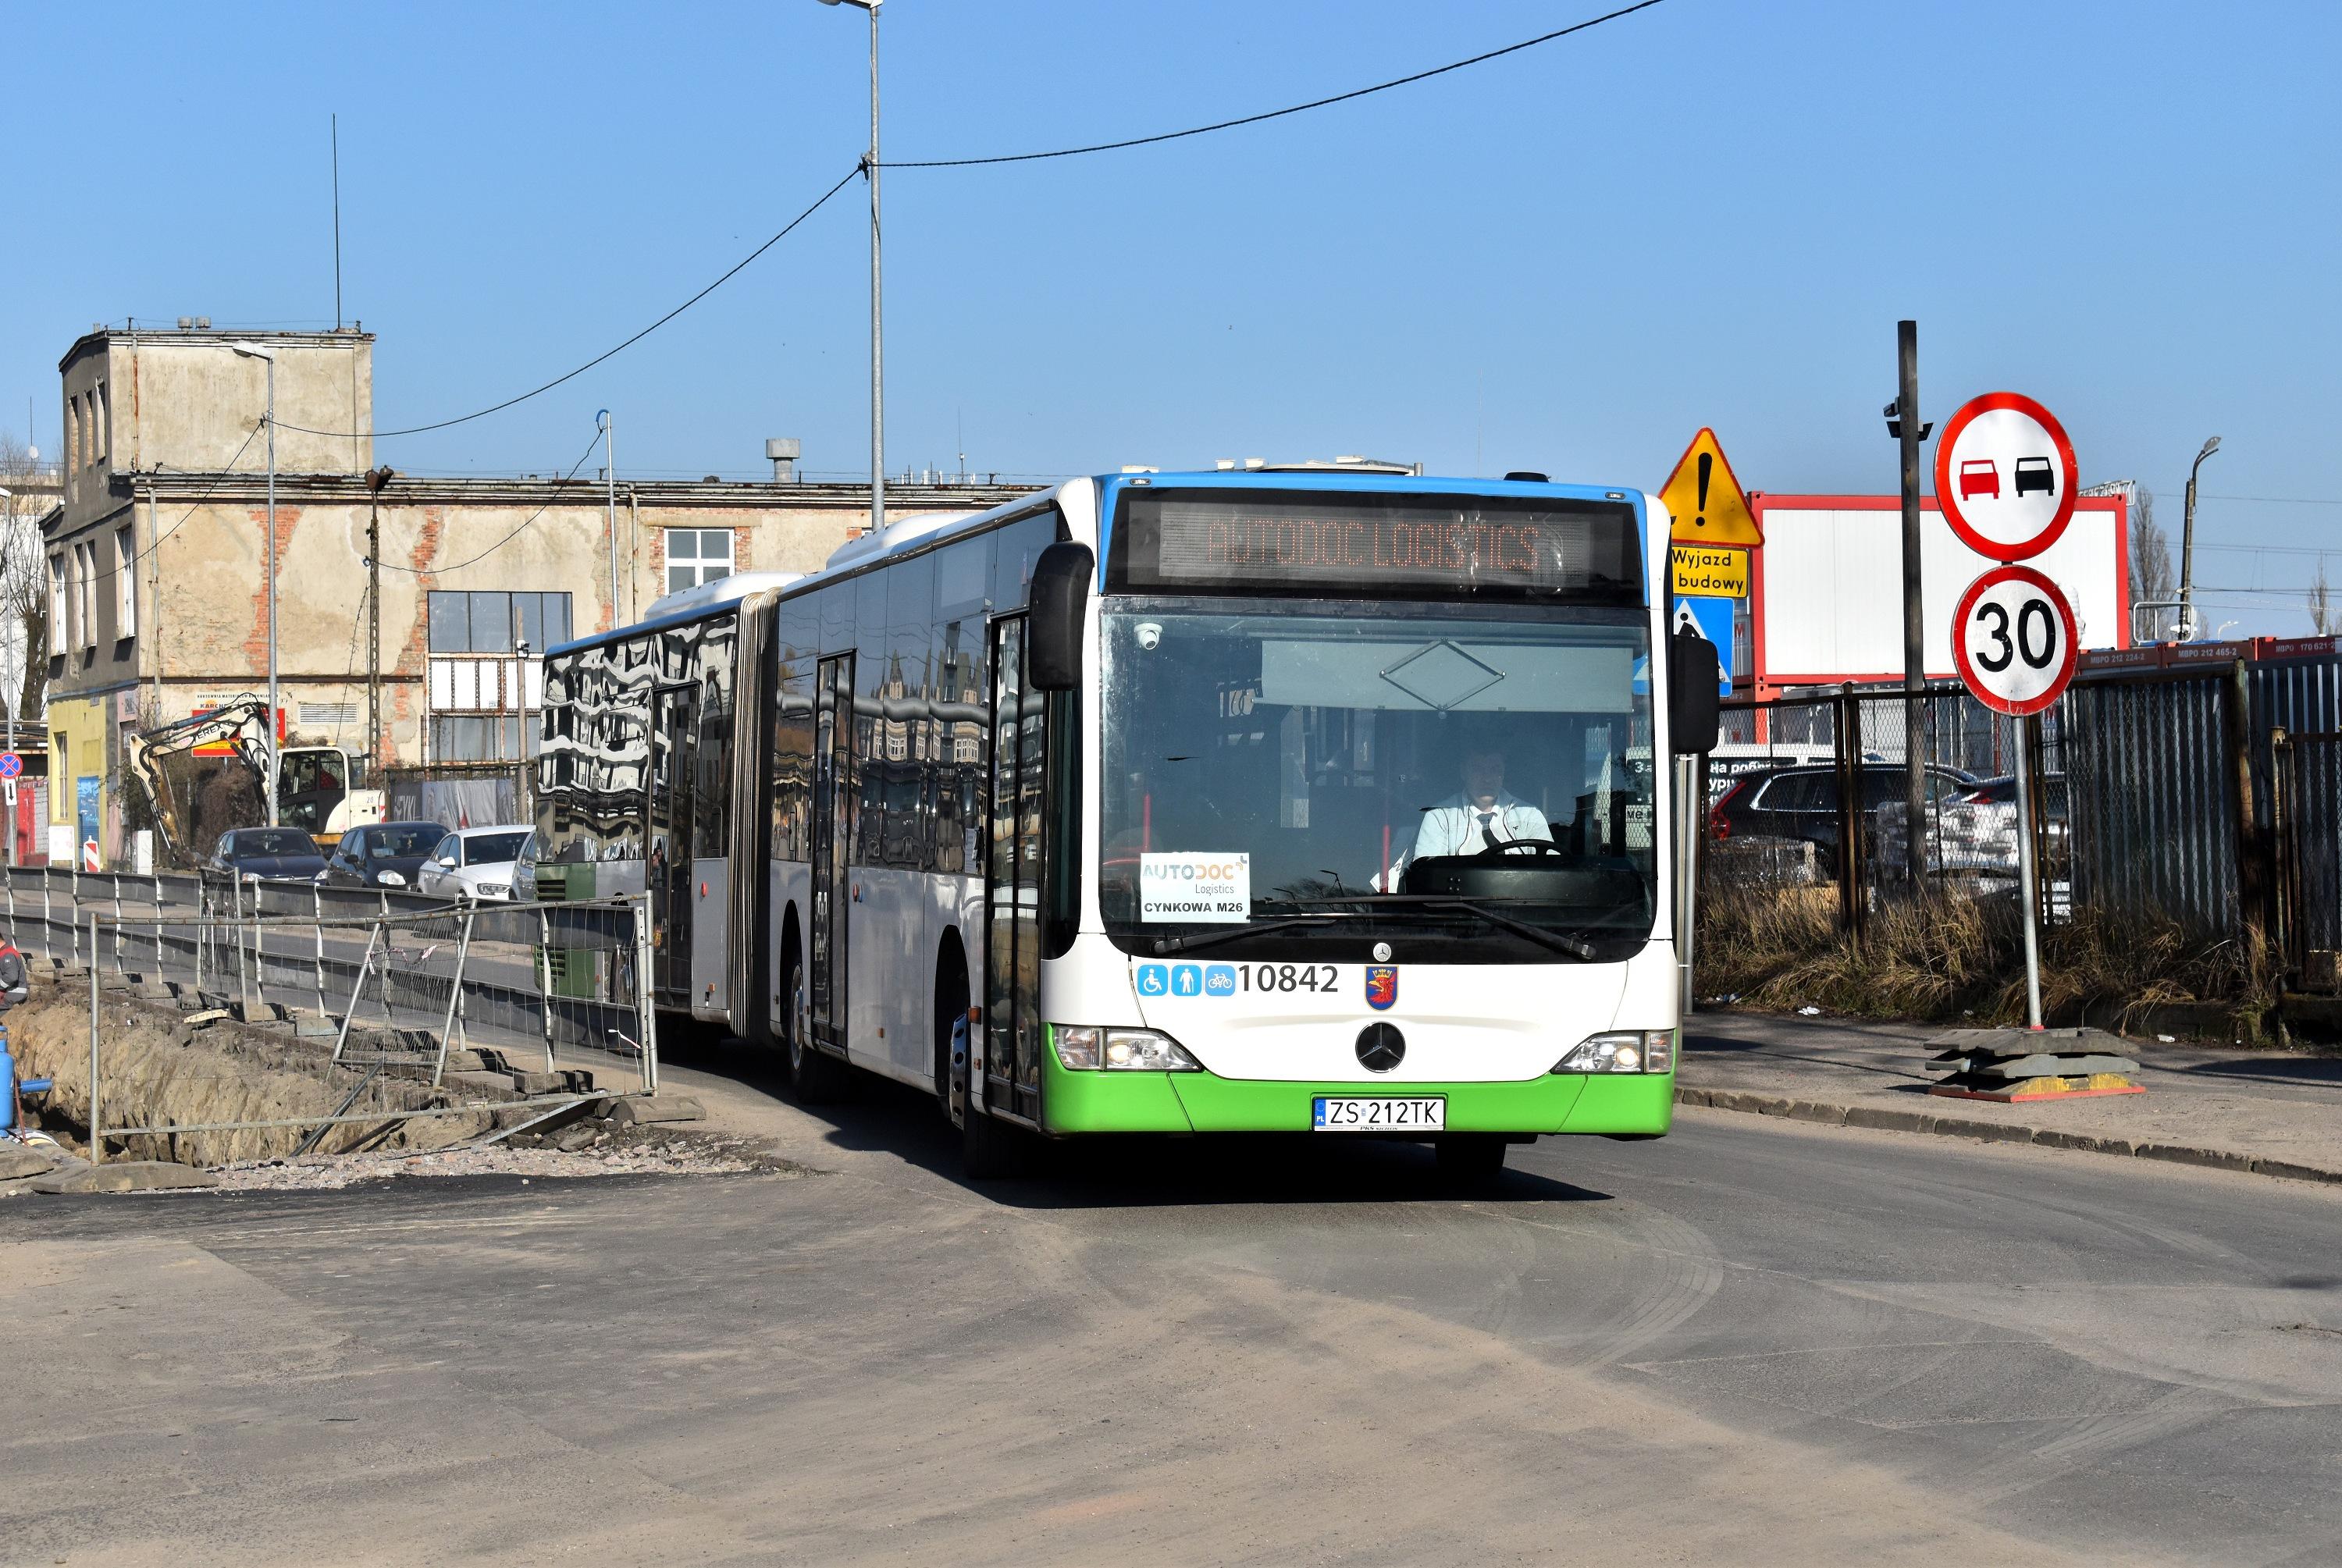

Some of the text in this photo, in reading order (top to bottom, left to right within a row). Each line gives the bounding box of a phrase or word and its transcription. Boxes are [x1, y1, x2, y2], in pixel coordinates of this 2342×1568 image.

[1208, 519, 1539, 570] AUTODOC LOGISTICS
[1672, 549, 1731, 569] Wyjazd
[1678, 573, 1743, 594] budowy
[1976, 599, 2055, 672] 30
[2112, 654, 2123, 663] 212
[2216, 647, 2237, 656] 465-2
[1142, 864, 1234, 880] AUTODOC
[1195, 884, 1234, 896] Logistics
[1144, 902, 1244, 912] CYNKOWA M26
[1238, 964, 1339, 993] 10842
[1330, 1101, 1359, 1124] ZS
[1369, 1101, 1437, 1124] 212TK
